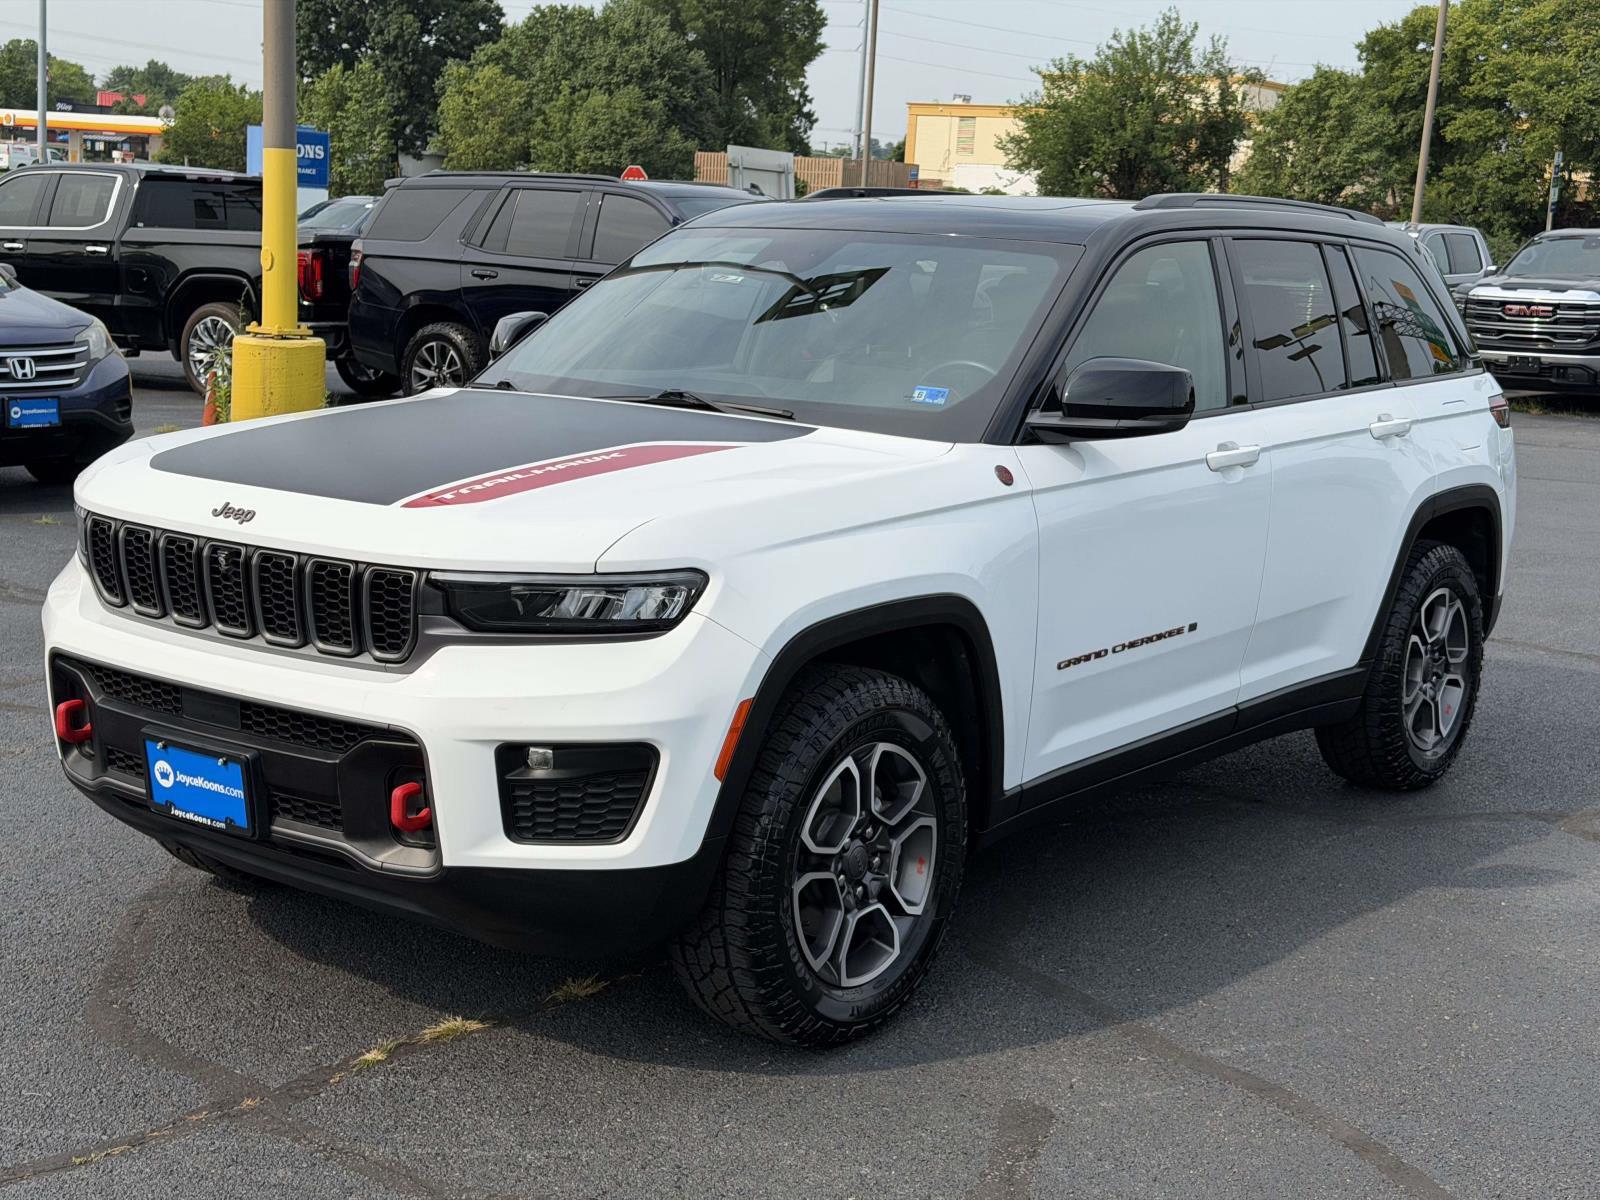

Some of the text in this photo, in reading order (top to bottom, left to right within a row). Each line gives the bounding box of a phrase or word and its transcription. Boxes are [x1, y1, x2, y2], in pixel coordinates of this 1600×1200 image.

[1504, 304, 1553, 317] GMC
[428, 451, 628, 501] TRAILHAWK
[211, 501, 257, 525] Jeep
[1056, 625, 1186, 671] GRAND CHEROKEE
[175, 770, 245, 799] JoyceKoons.com
[170, 806, 227, 830] JoyceKoons.com
